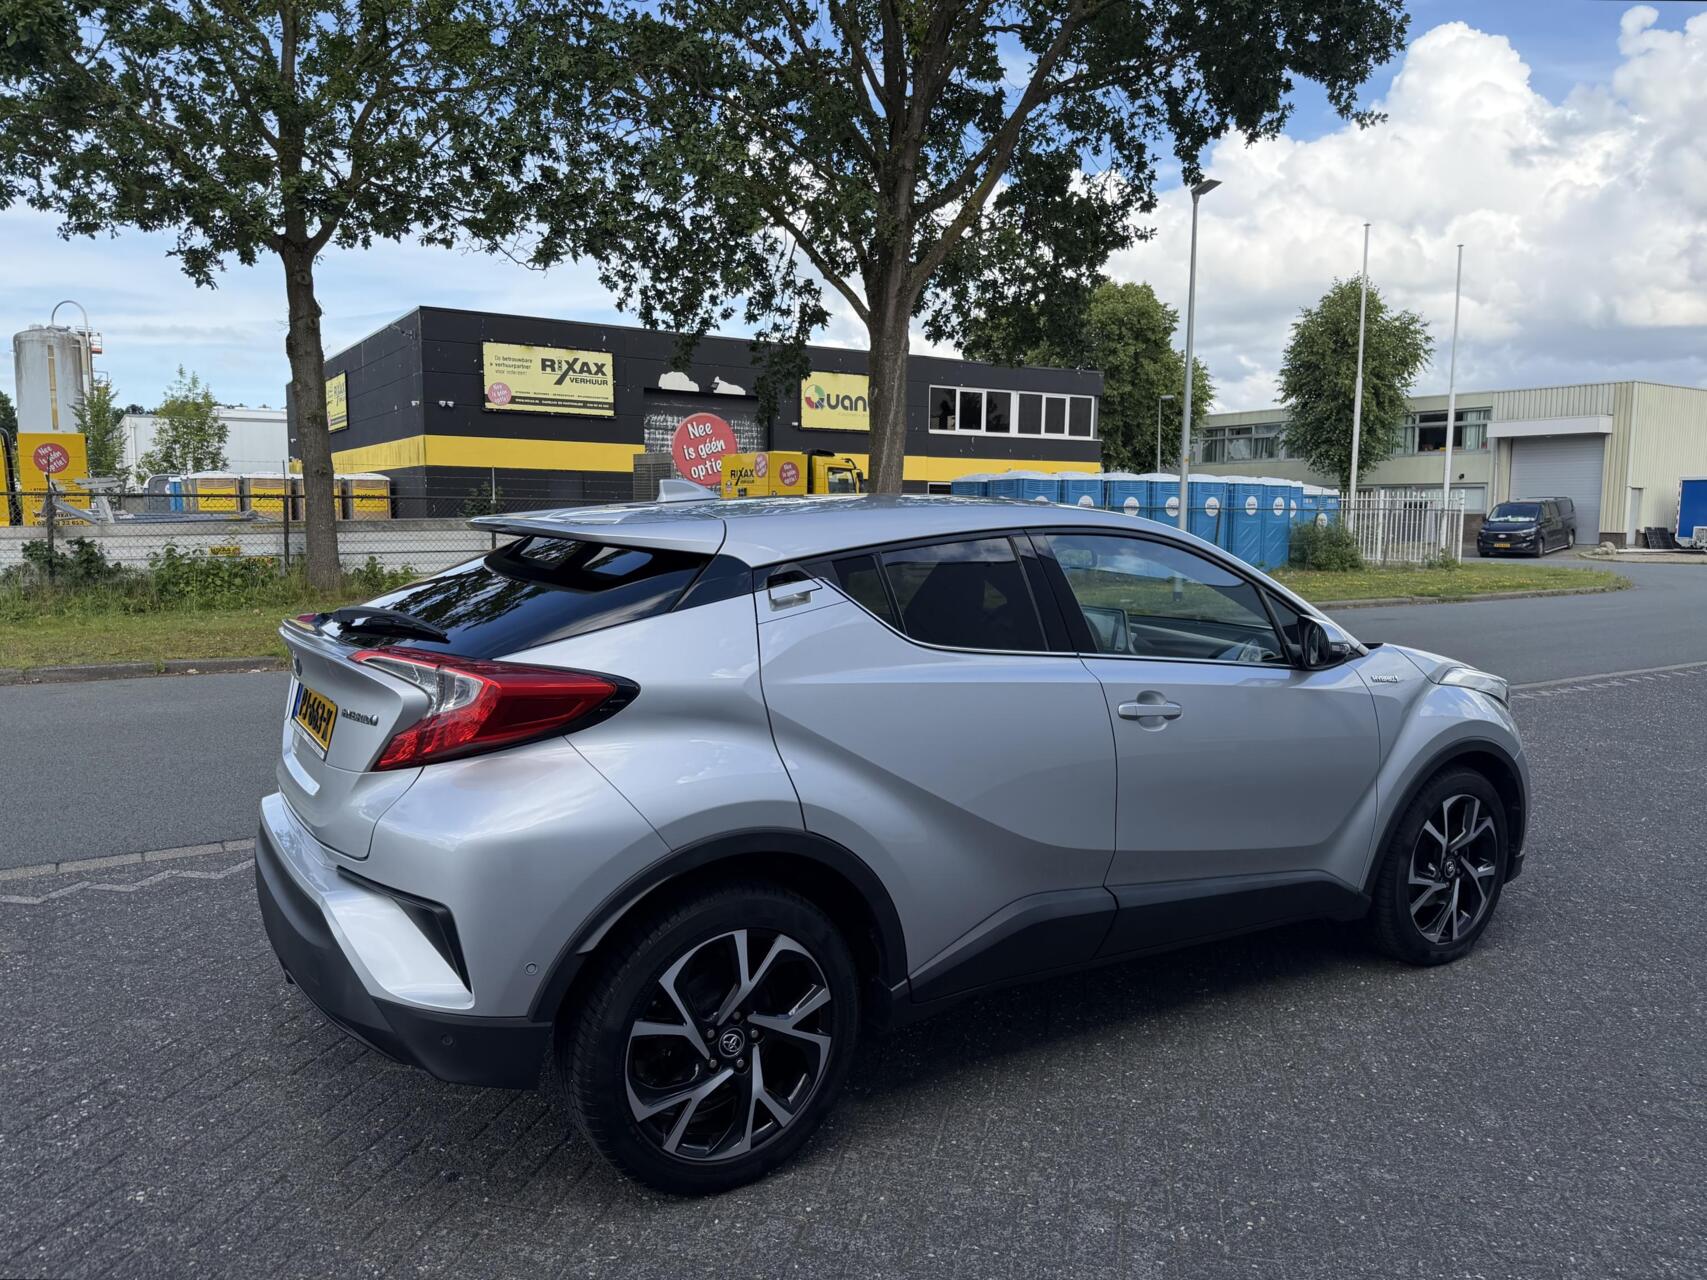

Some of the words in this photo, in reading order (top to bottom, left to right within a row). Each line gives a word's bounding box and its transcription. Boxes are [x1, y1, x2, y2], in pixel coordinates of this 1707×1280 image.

[569, 376, 609, 386] VERHUUR
[687, 421, 713, 439] Nee
[683, 444, 696, 460] is
[698, 437, 726, 459] géén
